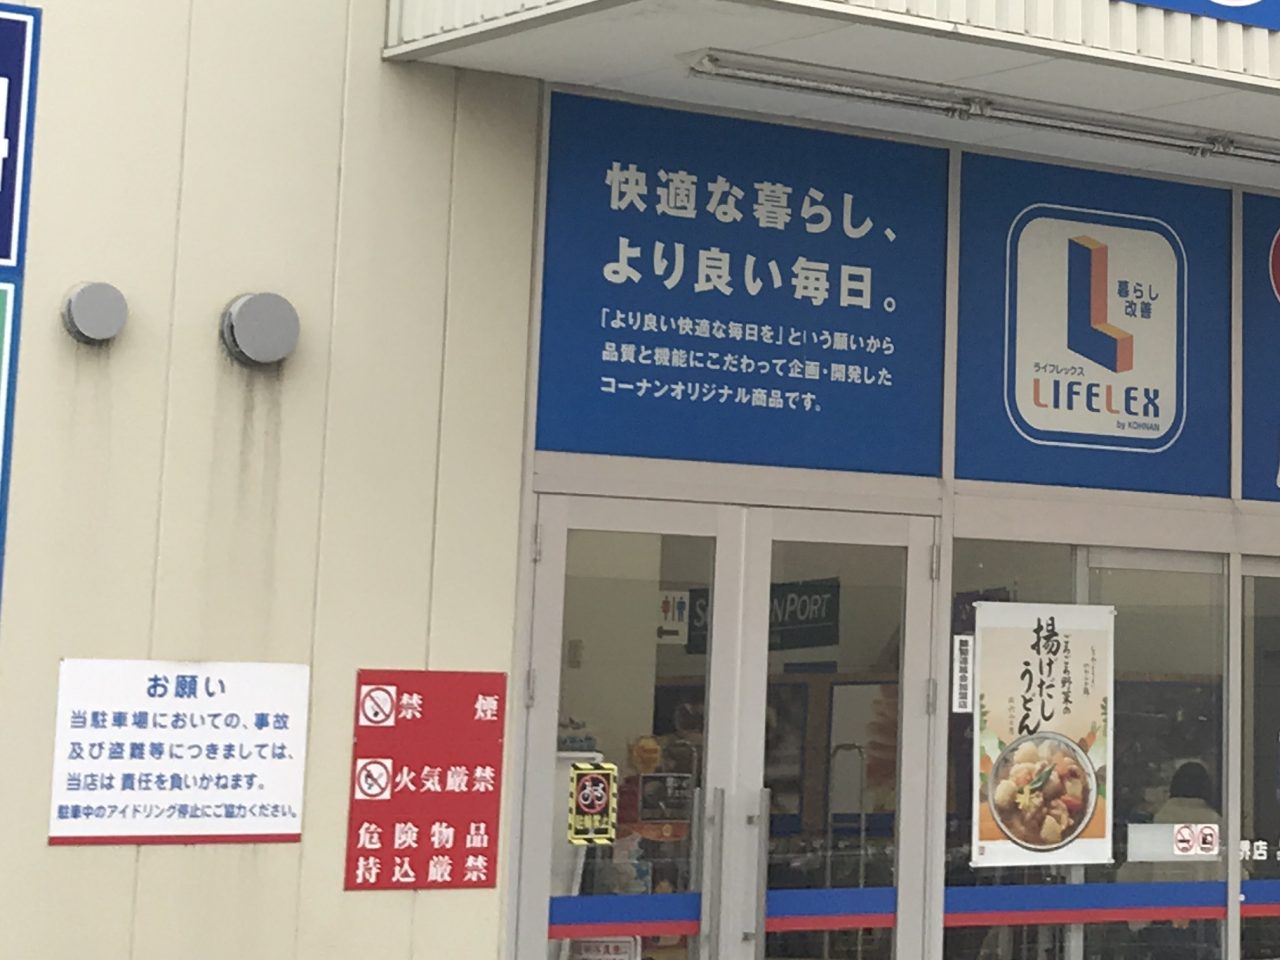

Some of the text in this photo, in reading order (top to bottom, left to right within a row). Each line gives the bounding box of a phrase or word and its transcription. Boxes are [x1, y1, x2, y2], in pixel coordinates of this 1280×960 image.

[604, 161, 897, 242] 快適な暮らし、
[602, 237, 896, 313] より良い毎日。
[1117, 280, 1159, 302] 暮らし
[1124, 300, 1152, 319] 改善
[600, 341, 893, 386] 品質と機能にこだわって企画・開発した
[1033, 361, 1085, 377] ライフレックス
[600, 375, 822, 412] コーナンオリジナル商品です。
[1033, 378, 1159, 418] LIFELEX
[1031, 616, 1061, 721] 揚げだし
[146, 674, 226, 698] お願い
[1018, 661, 1040, 735] うどん
[70, 710, 289, 730] 当駐車場においての、事故
[398, 693, 499, 723] 禁煙
[67, 742, 294, 760] 及び盗難等につきましては、
[394, 765, 496, 793] 火気厳禁
[357, 822, 489, 849] 危険物品
[354, 855, 489, 884] 持込厳禁
